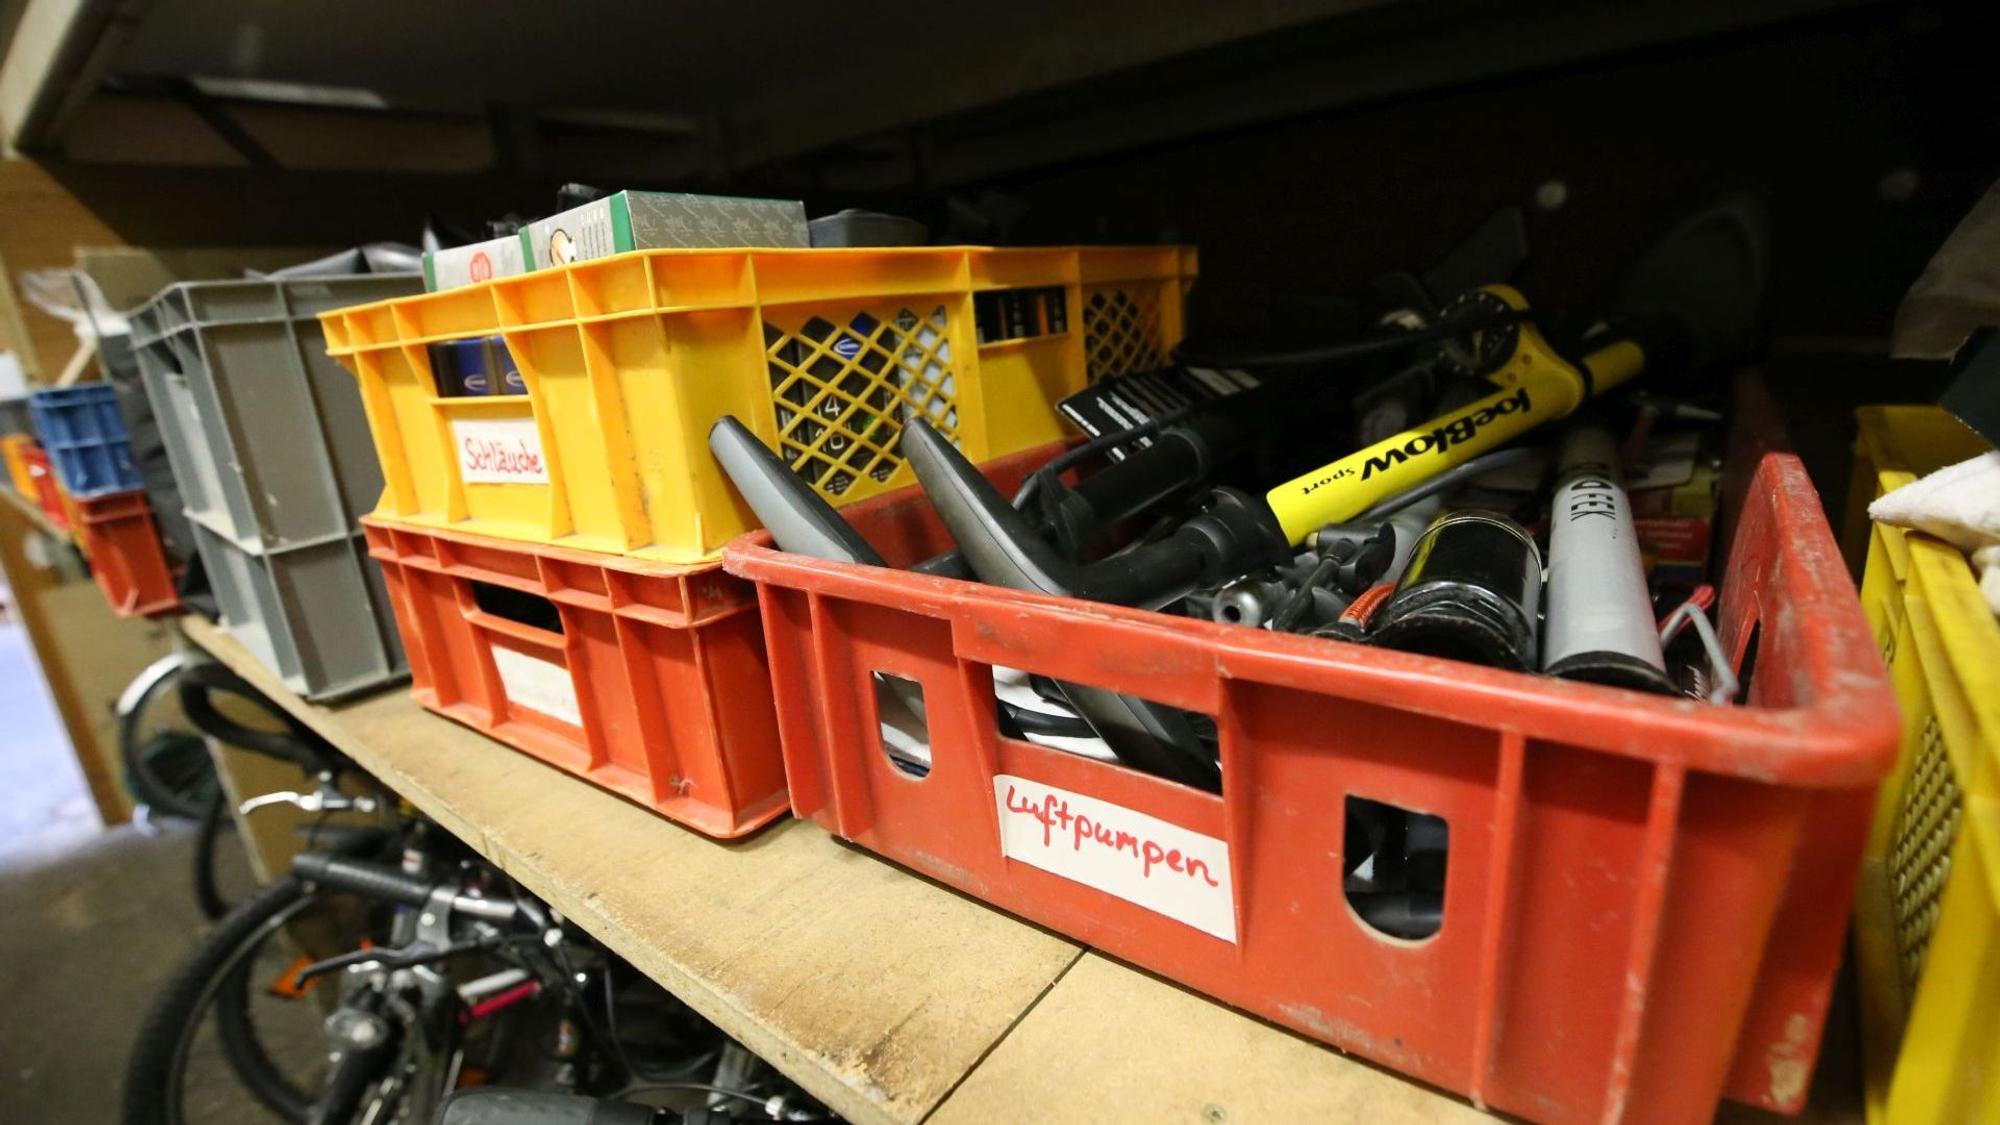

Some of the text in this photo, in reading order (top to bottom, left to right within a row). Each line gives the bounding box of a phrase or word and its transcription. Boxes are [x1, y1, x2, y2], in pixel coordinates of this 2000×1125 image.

[465, 438, 543, 474] Schläuche
[1302, 387, 1531, 495] JoeBlow Sport
[1006, 784, 1218, 888] Luftpumpen
